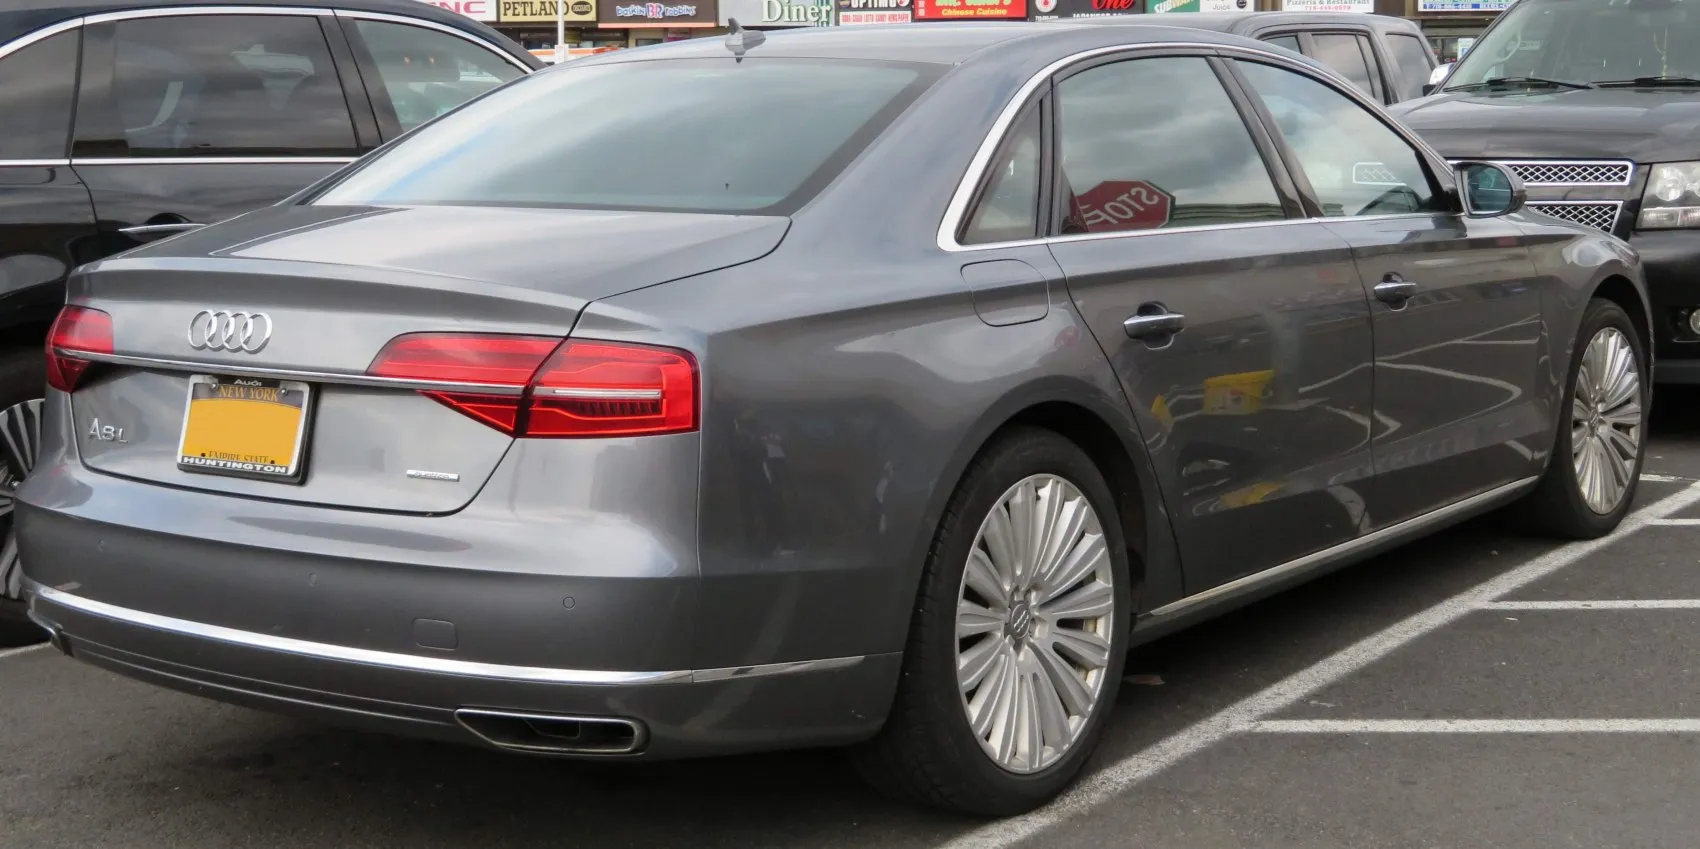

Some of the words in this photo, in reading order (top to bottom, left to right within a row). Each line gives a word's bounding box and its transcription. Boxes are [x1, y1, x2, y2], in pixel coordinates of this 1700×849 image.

[430, 1, 486, 14] NC
[762, 0, 831, 22] Diner
[1154, 0, 1195, 13] SUBWA
[220, 385, 246, 399] NEW
[250, 387, 279, 402] YORK
[183, 456, 289, 474] HUNTINGTON
[244, 455, 269, 464] STATE
